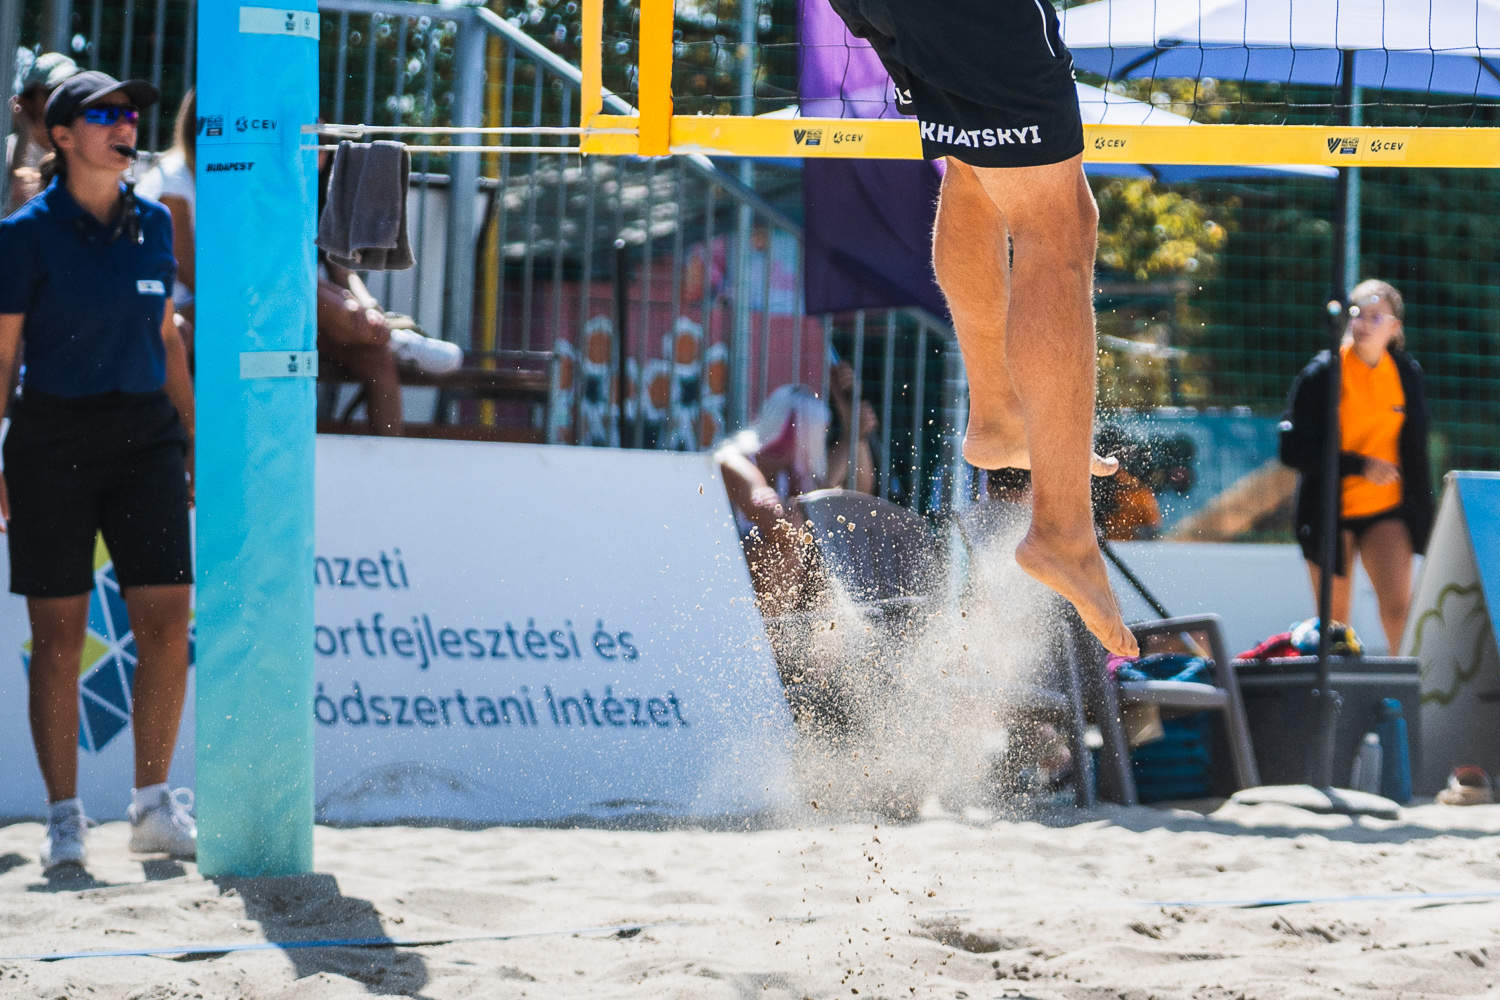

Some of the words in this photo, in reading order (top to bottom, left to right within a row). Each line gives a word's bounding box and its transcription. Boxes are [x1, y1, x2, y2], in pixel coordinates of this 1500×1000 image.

[845, 133, 863, 141] CEV
[920, 120, 1042, 148] KHATSKYI
[1108, 139, 1126, 147] CEV
[1384, 142, 1404, 150] CEV
[206, 162, 255, 172] BUDAPEST
[314, 613, 582, 670] ortfejlesztési
[593, 617, 640, 661] és
[314, 681, 538, 728] ódszertani
[545, 684, 690, 728] Intézet
